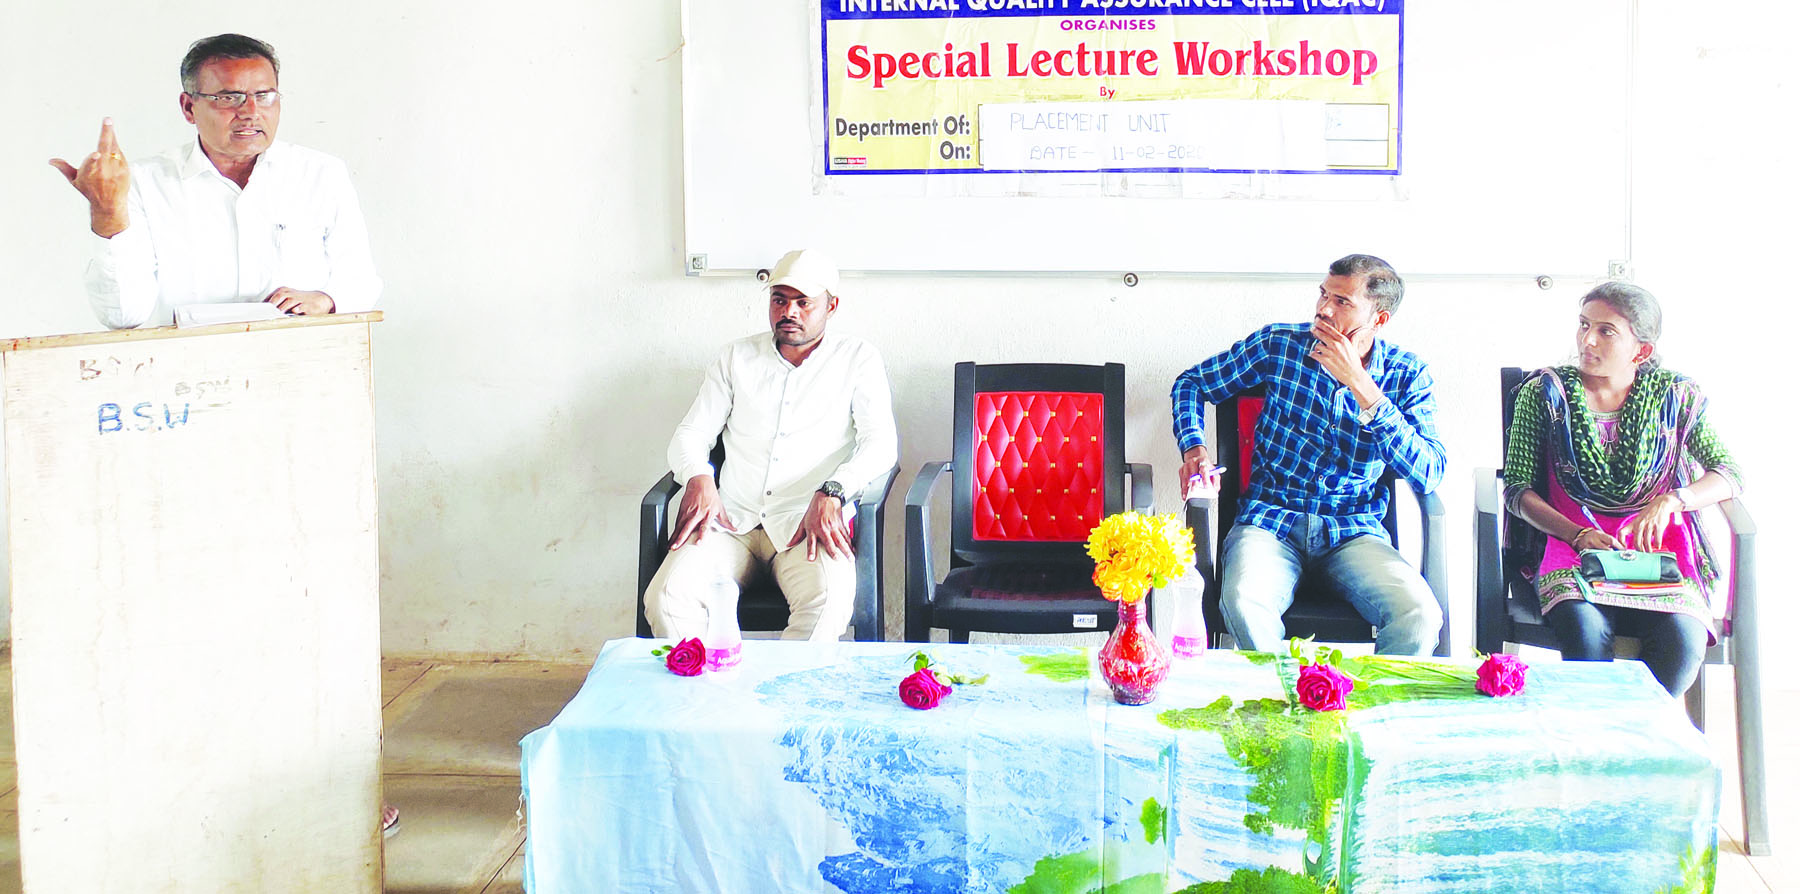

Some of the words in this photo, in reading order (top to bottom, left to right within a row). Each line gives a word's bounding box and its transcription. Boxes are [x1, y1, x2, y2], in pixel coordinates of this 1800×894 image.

[1060, 19, 1156, 31] ORGANISES
[847, 42, 991, 89] Special
[1007, 42, 1159, 77] Lecture
[1173, 40, 1378, 86] Workshop
[1100, 86, 1116, 99] By
[835, 118, 939, 142] Department
[943, 114, 970, 135] Of:
[1010, 112, 1109, 132] PLACEMENT
[1128, 113, 1172, 133] UNIT
[940, 140, 971, 160] On:
